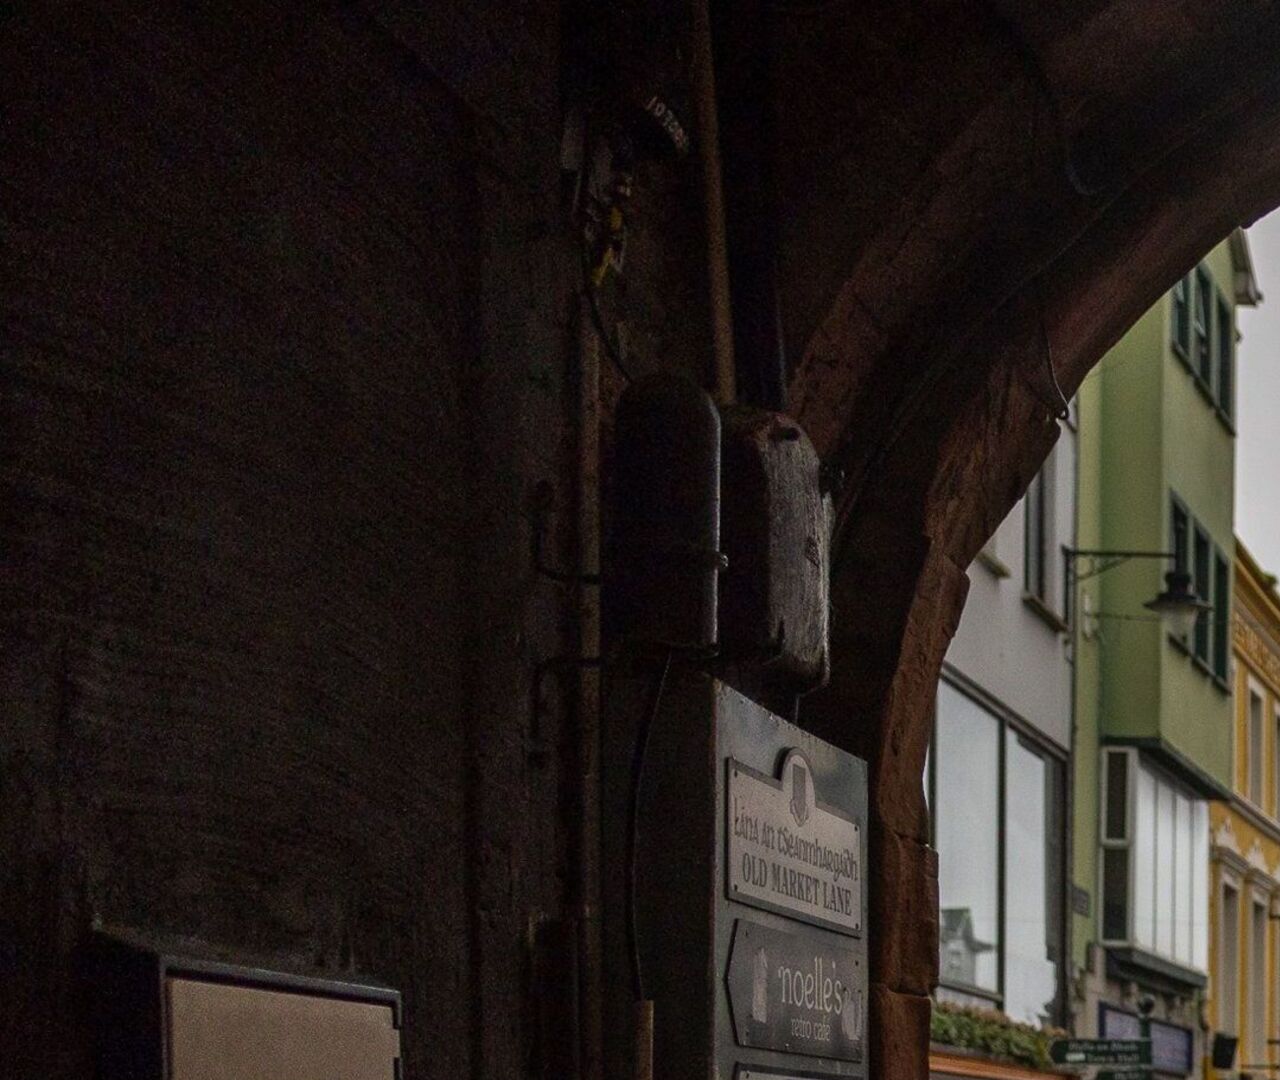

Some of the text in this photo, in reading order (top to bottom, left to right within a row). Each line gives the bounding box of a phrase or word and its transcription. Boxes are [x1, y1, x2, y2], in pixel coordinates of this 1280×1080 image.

[742, 852, 852, 916] OLD MARKET LANE
[777, 956, 843, 1016] noelle's
[790, 1016, 810, 1040] retro
